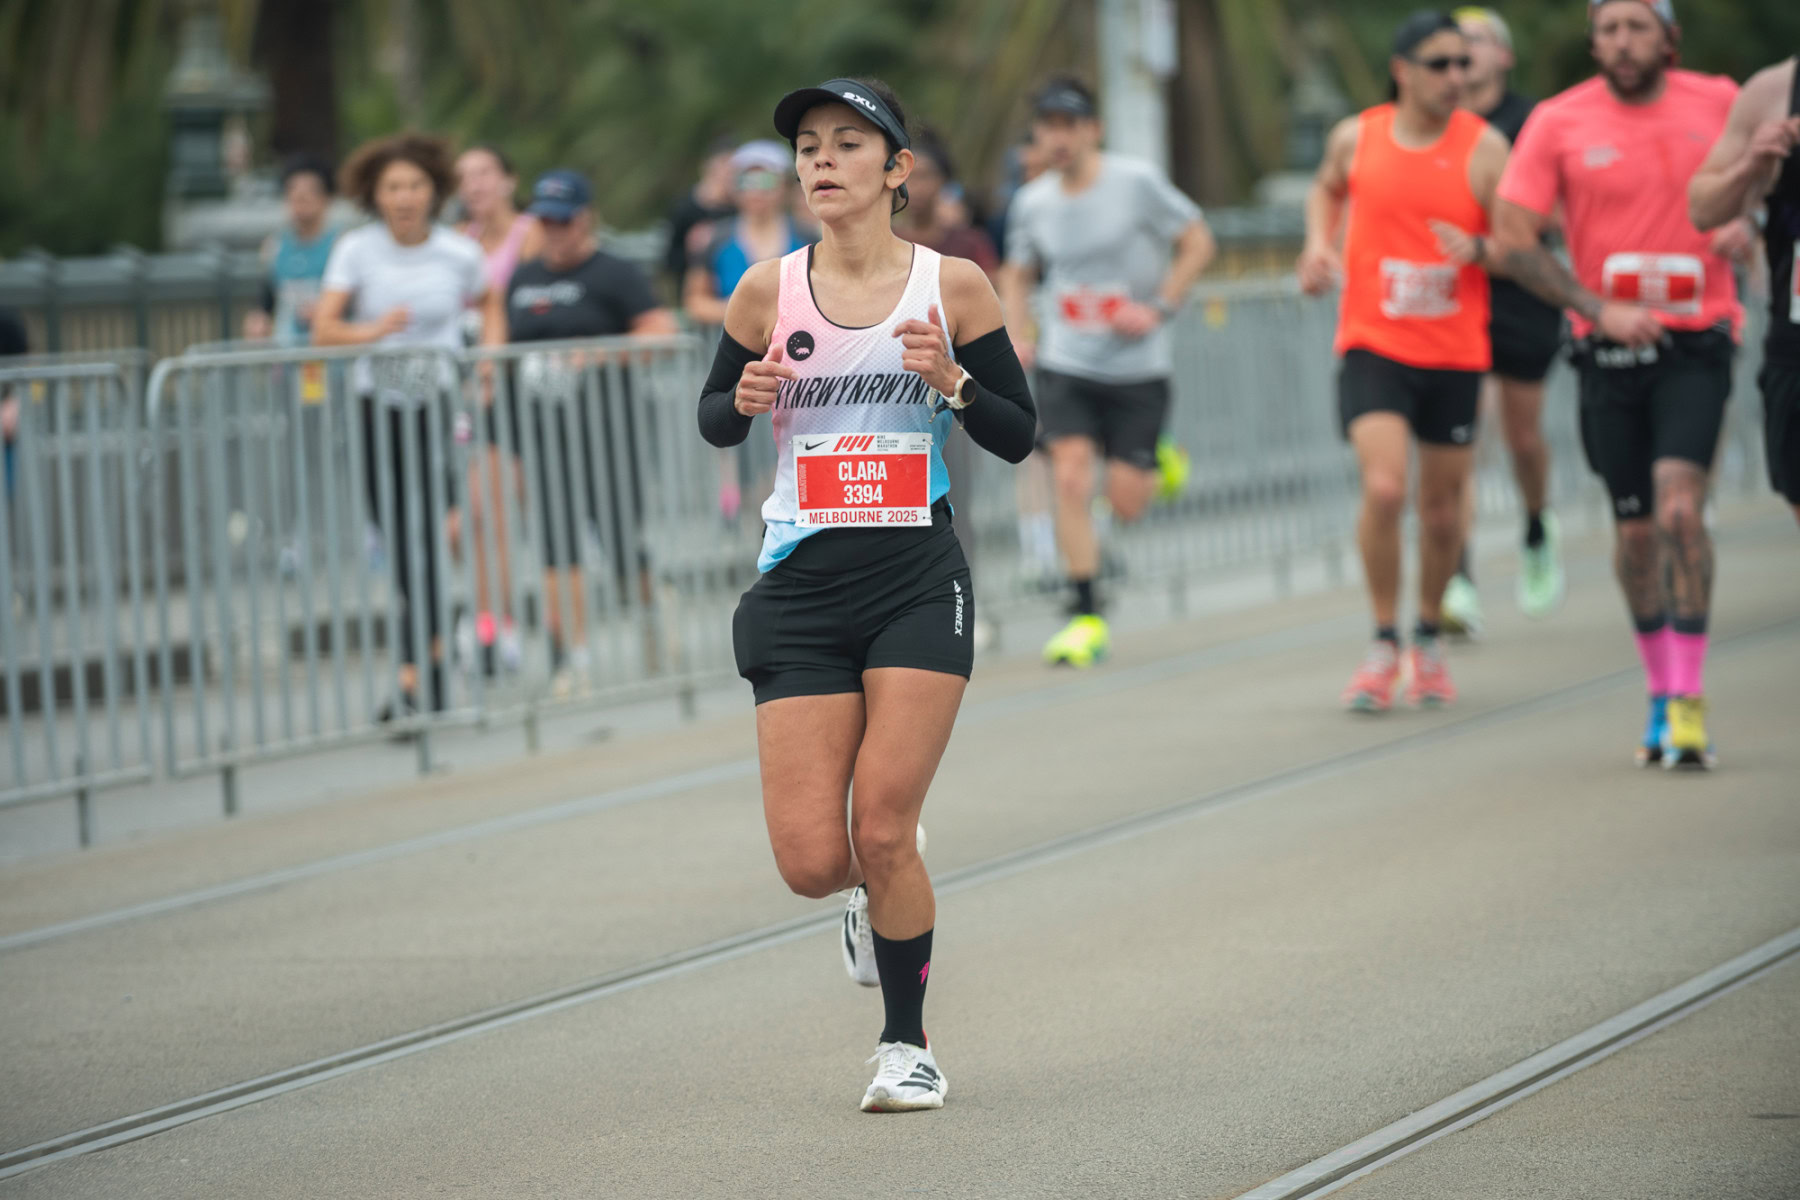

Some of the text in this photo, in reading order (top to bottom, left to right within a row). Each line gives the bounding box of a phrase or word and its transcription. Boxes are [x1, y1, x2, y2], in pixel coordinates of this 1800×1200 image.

[842, 91, 877, 111] 2XU
[838, 461, 888, 481] CLARA
[843, 484, 884, 504] 3394
[809, 510, 918, 525] MELBOURNE 2025
[954, 593, 964, 637] TERREX
